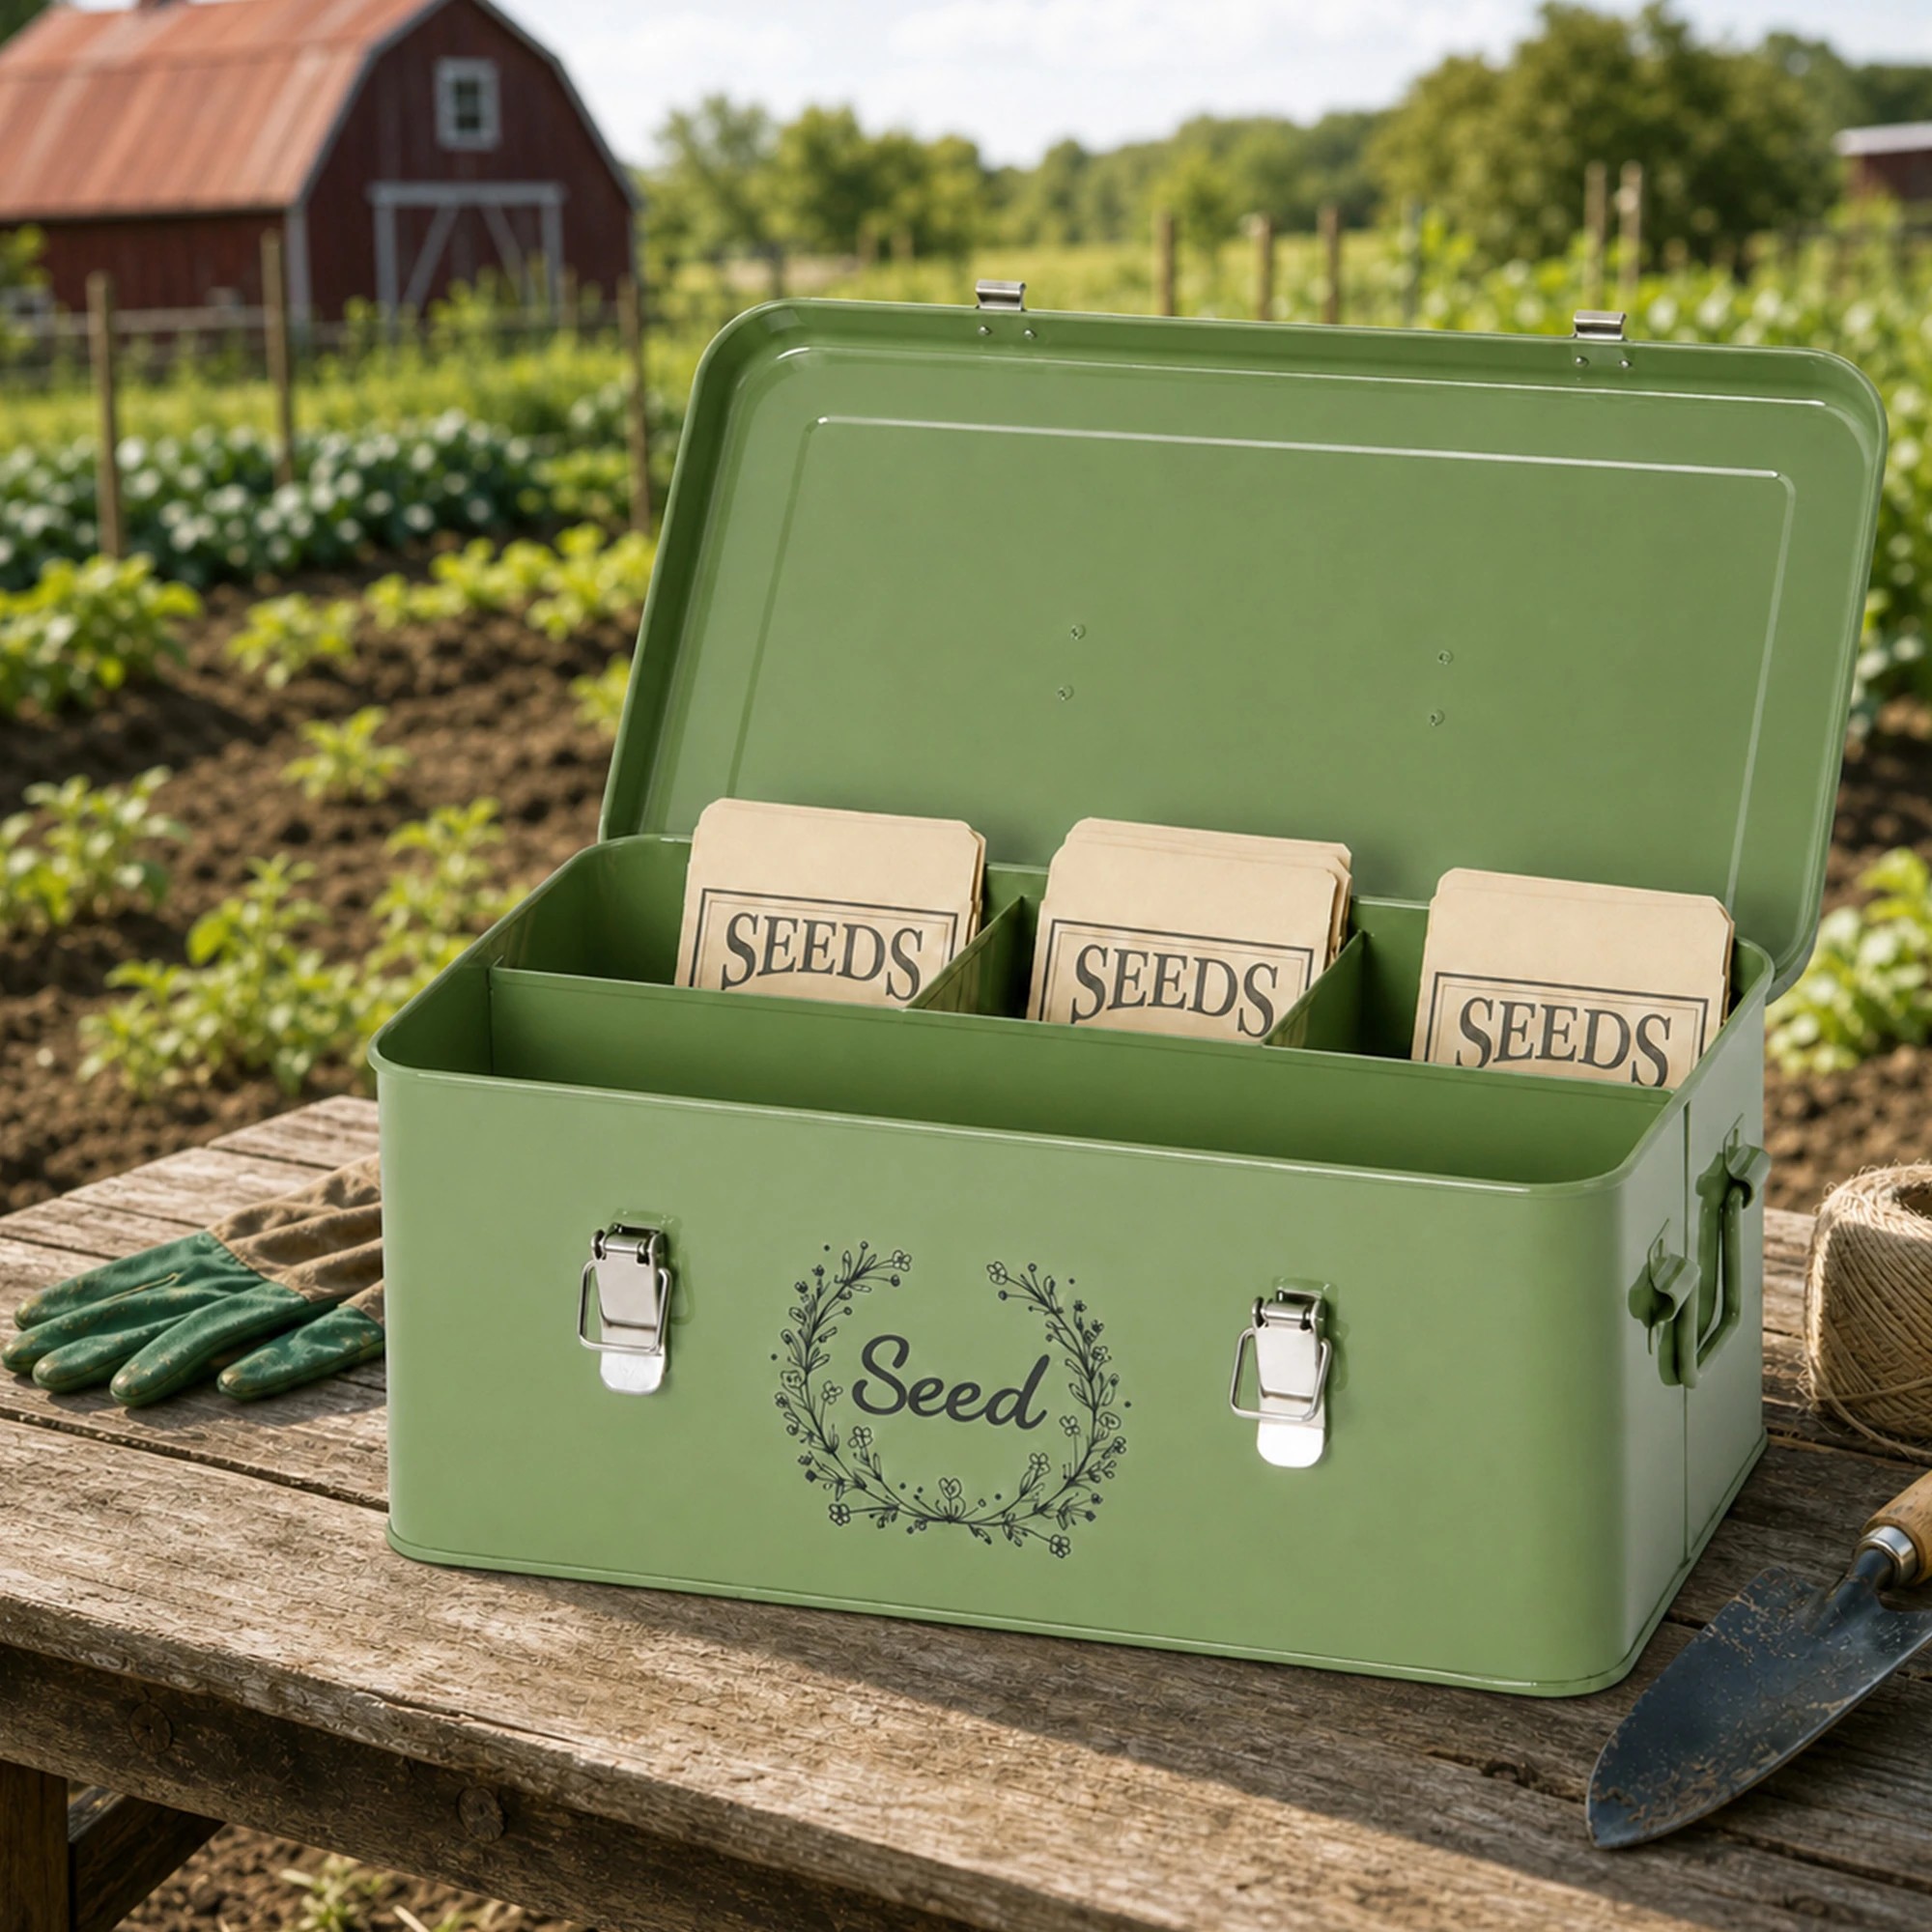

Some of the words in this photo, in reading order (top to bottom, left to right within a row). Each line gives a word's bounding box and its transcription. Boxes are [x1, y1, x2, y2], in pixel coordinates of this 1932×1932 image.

[721, 913, 923, 1001] SEEDS
[1070, 945, 1278, 1037] SEEDS
[1456, 997, 1672, 1088] SEEDS
[852, 1335, 1050, 1430] Seed
